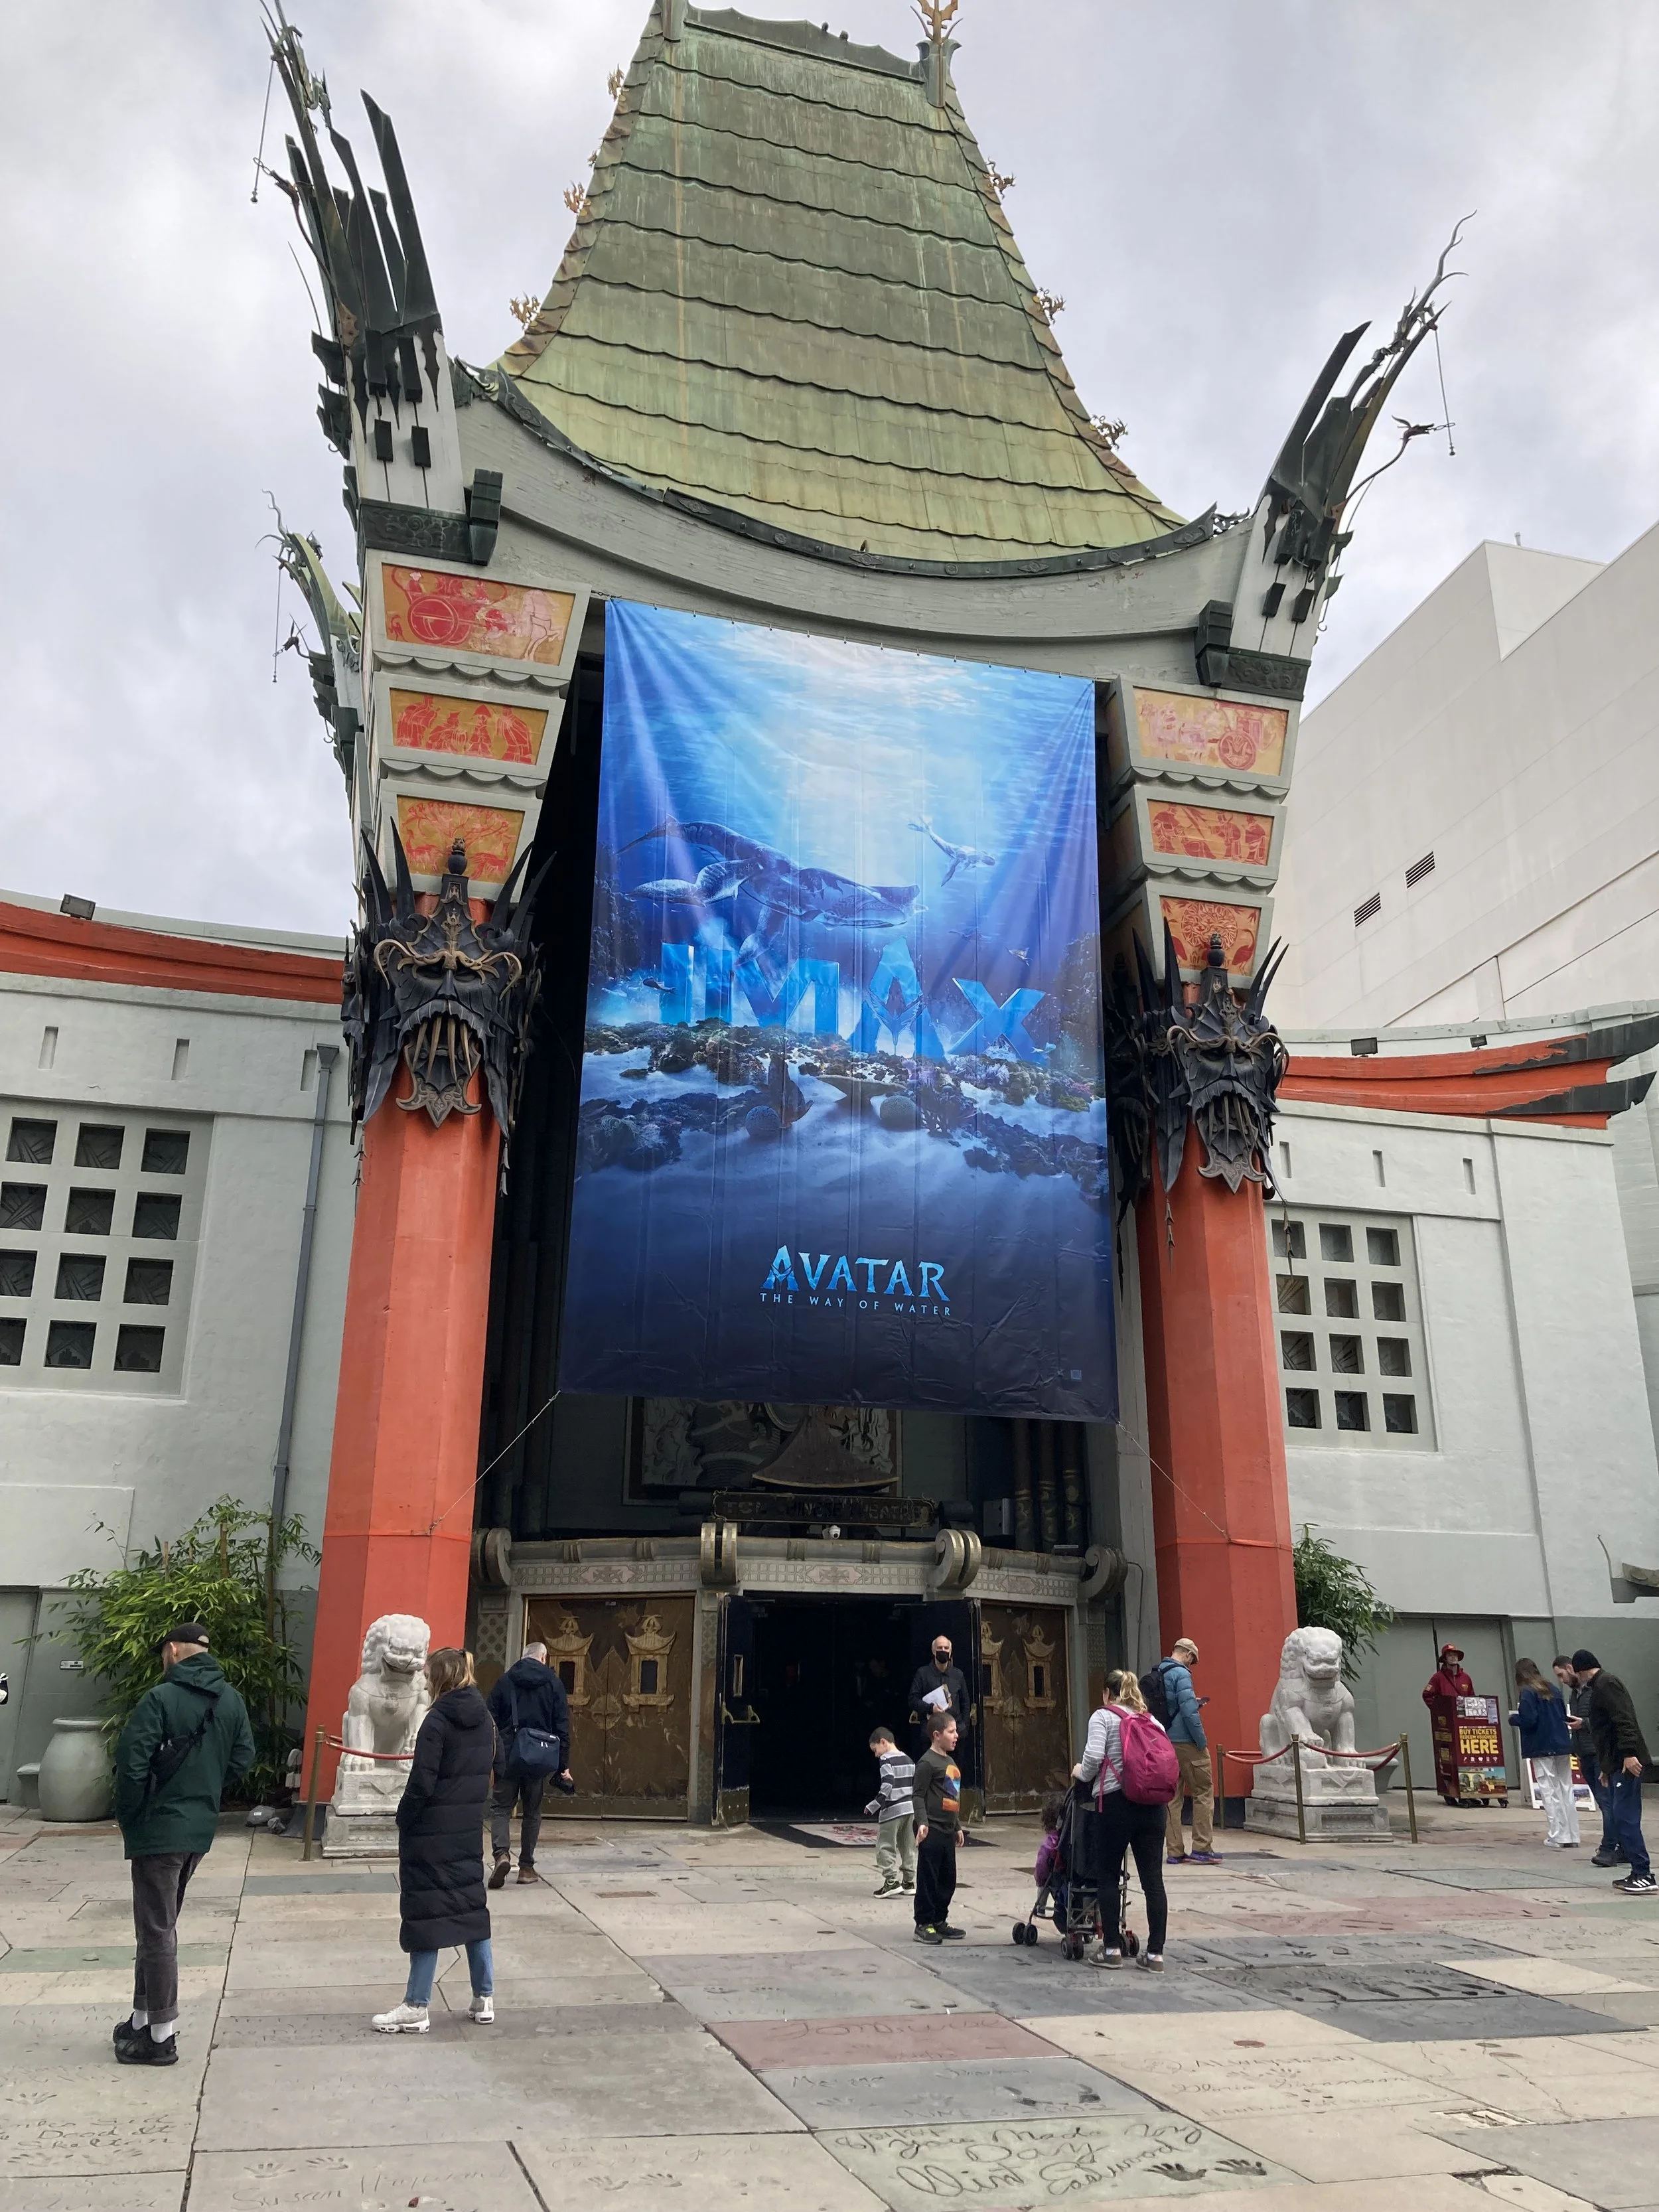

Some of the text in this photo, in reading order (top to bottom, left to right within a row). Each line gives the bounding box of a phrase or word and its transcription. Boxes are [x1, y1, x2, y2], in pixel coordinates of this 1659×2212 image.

[660, 935, 1048, 1063] IMAX
[760, 1245, 950, 1301] AVATAR
[760, 1293, 950, 1316] THE WAY OF WATER
[1460, 1739, 1499, 1754] HERE
